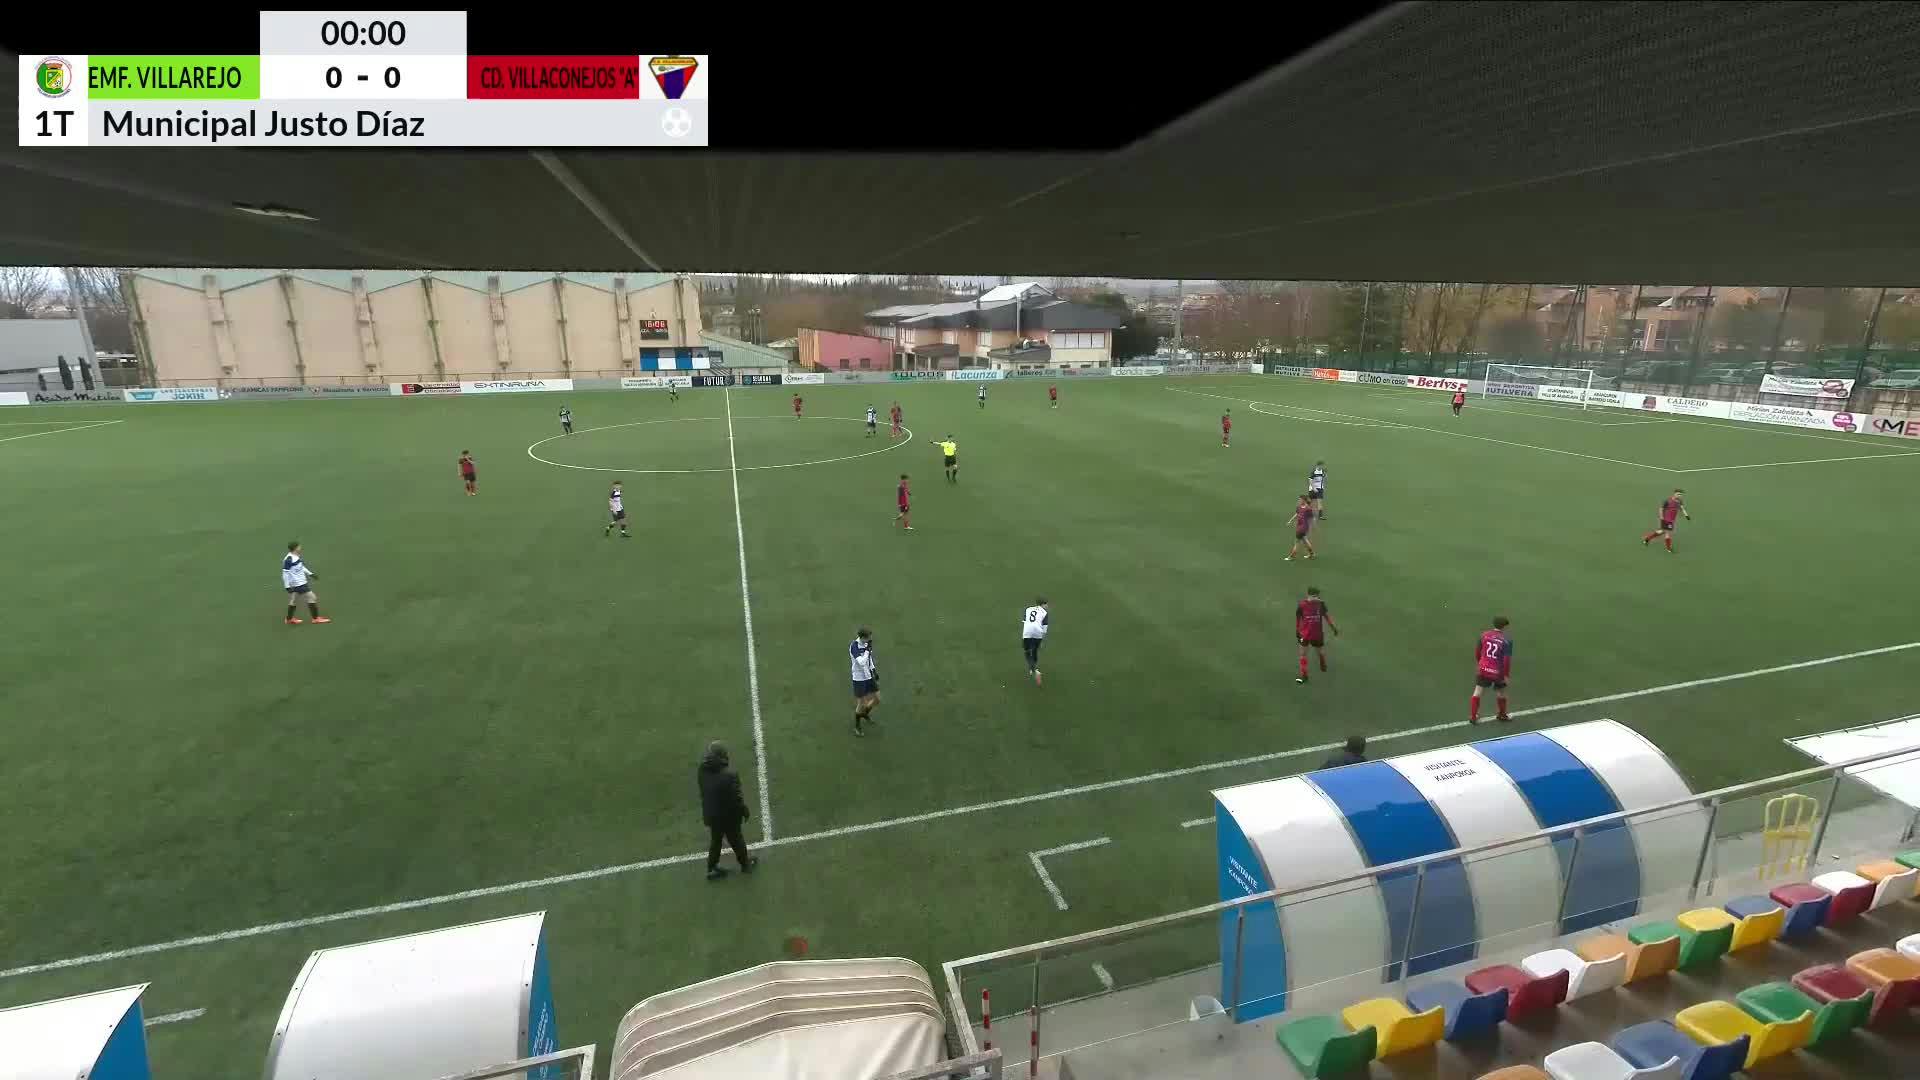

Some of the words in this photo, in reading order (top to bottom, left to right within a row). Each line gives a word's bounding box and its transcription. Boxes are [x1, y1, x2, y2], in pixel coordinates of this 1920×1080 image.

[1030, 610, 1037, 622] 8
[1486, 641, 1498, 659] 22
[1424, 759, 1466, 771] VISITANTE
[1229, 855, 1258, 889] VISITANTE
